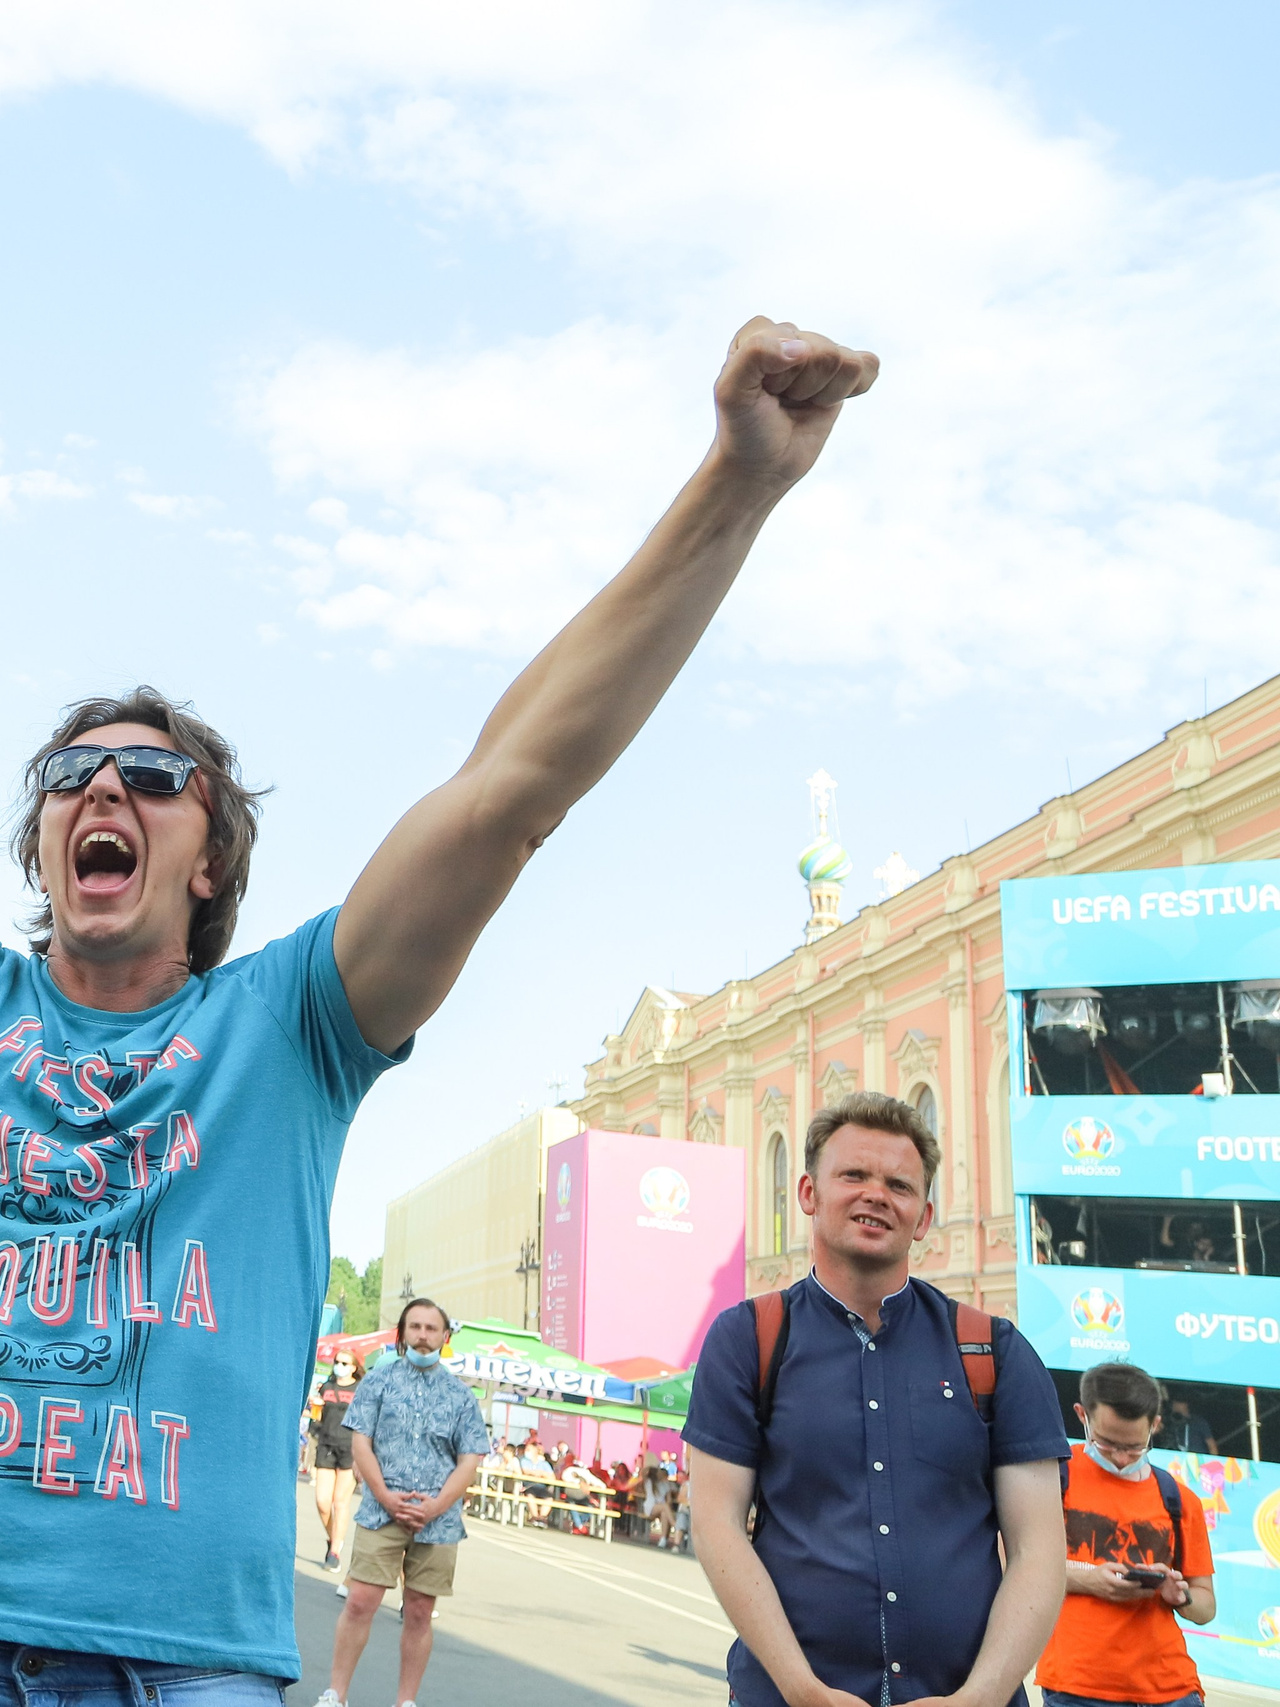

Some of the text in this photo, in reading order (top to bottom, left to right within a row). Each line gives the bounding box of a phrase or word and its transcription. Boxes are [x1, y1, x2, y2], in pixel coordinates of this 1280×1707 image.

[1052, 884, 1280, 924] UEFA FESTIVA
[439, 1352, 608, 1398] eineken
